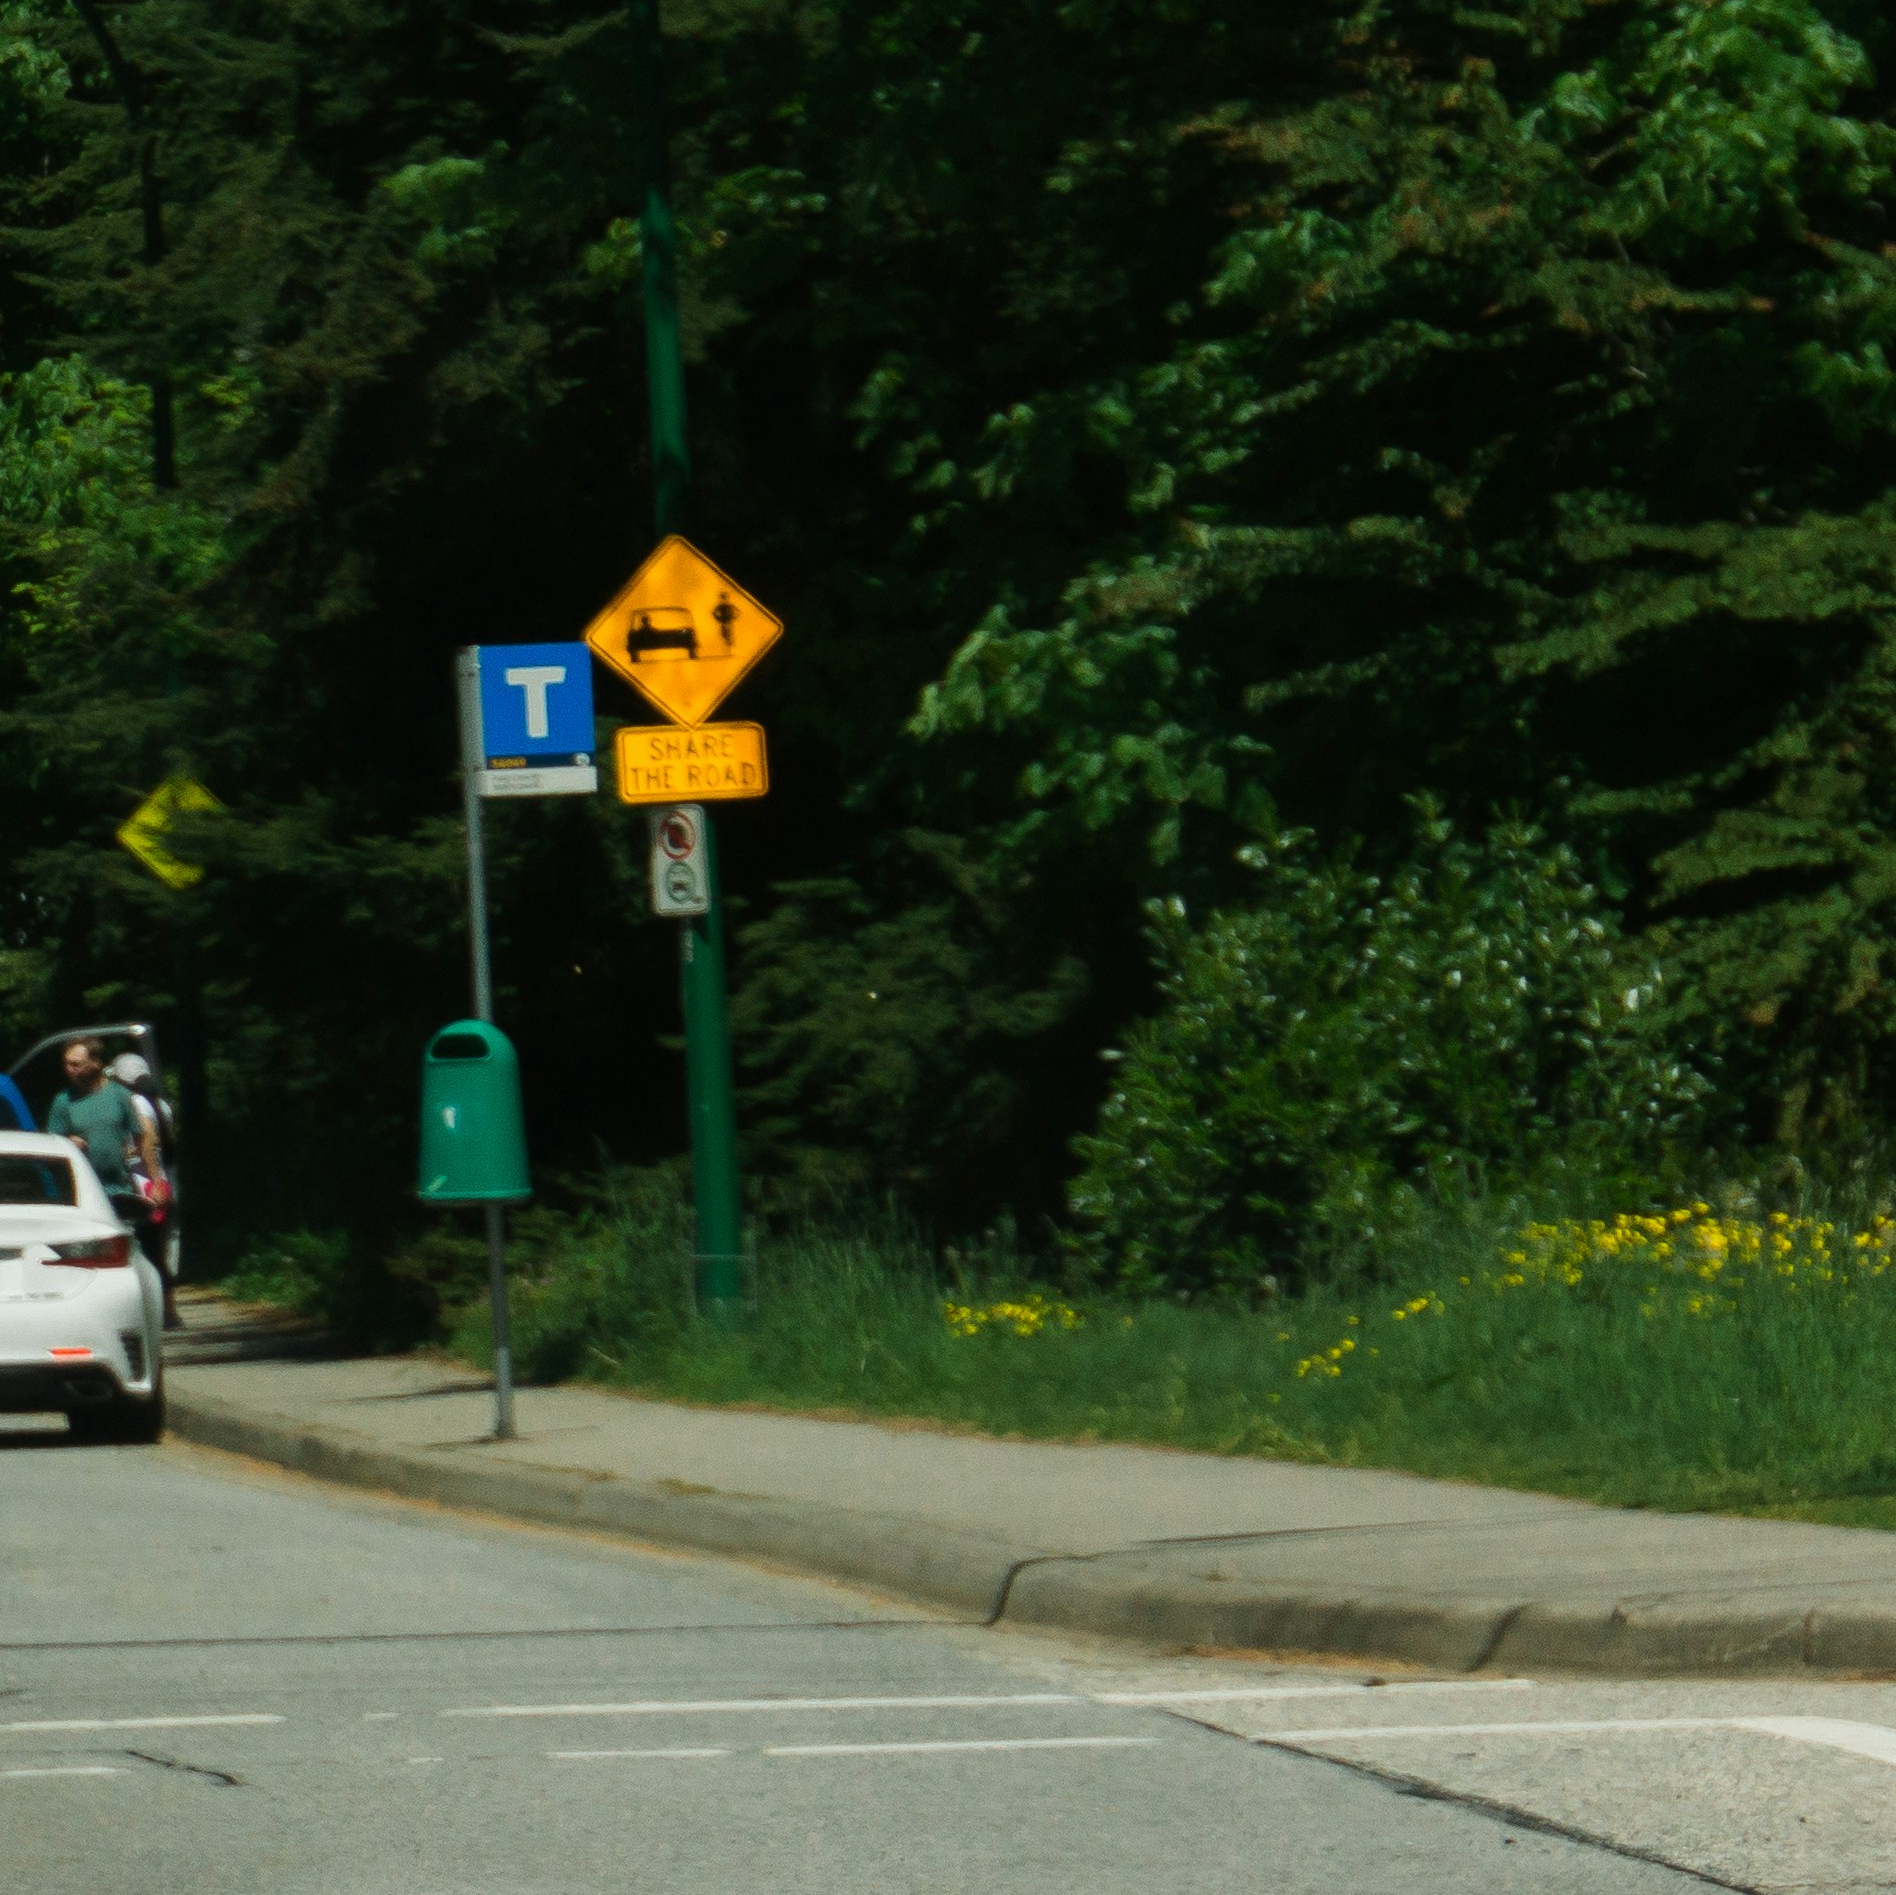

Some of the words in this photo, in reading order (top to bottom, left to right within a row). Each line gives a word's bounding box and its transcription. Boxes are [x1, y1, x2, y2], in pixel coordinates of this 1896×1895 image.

[505, 665, 566, 737] T
[650, 733, 734, 761] SHARE
[631, 765, 674, 791] THE
[688, 761, 756, 789] ROAD
